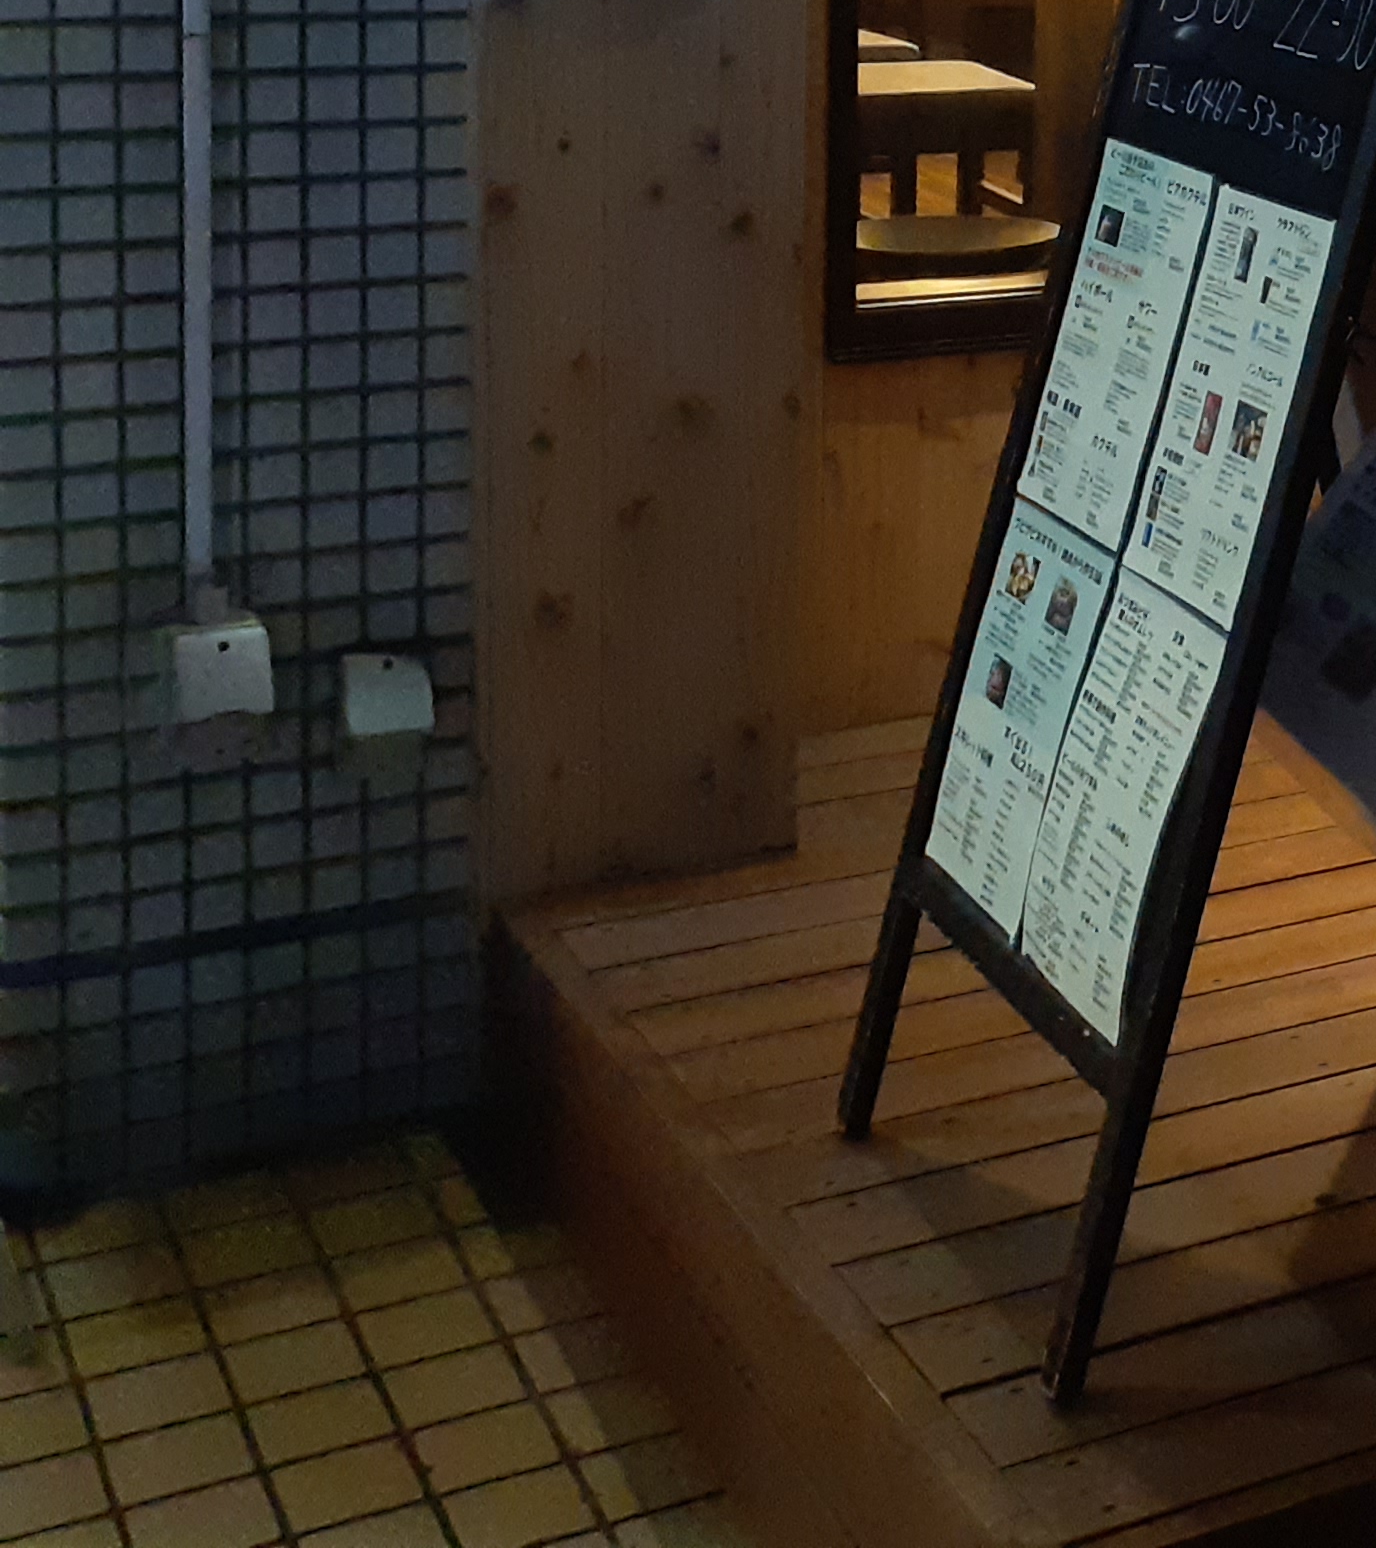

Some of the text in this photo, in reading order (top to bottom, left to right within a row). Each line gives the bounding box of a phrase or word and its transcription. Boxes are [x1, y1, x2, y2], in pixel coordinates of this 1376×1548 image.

[1079, 275, 1114, 303] ハイボール
[1136, 300, 1160, 317] サワー
[1089, 431, 1119, 460] カクテル
